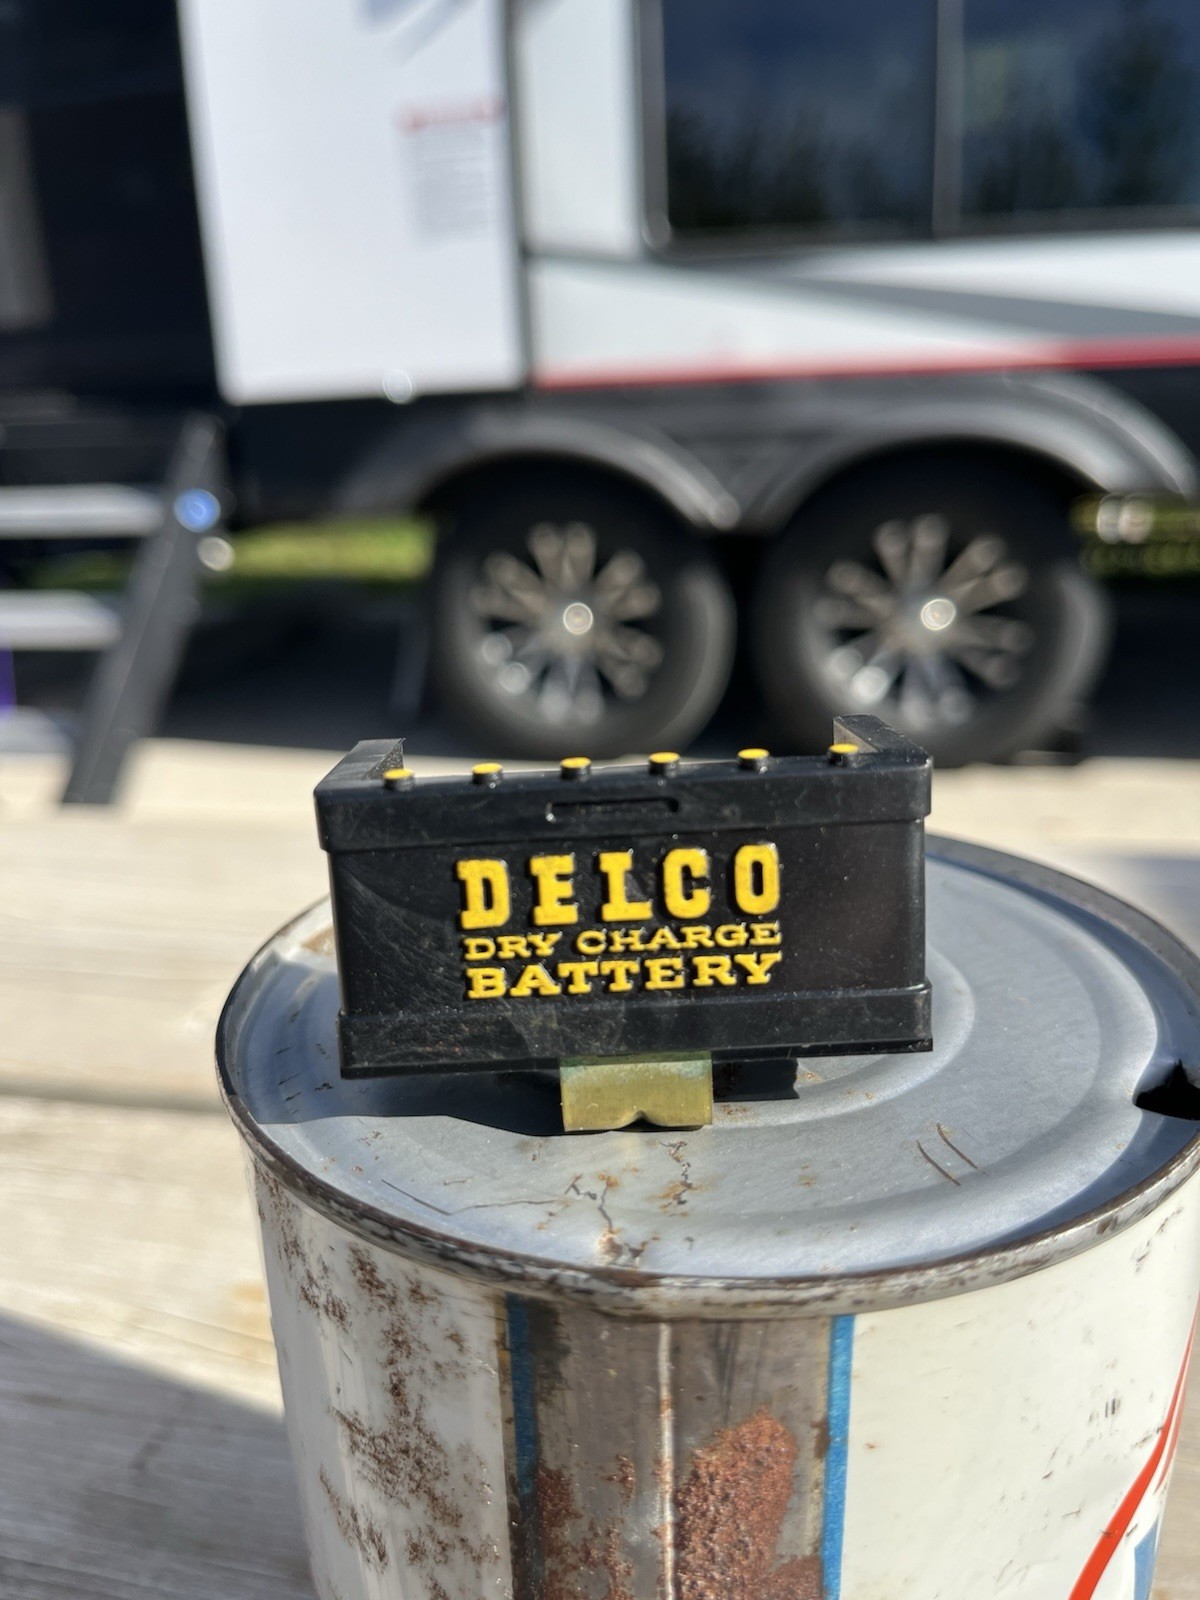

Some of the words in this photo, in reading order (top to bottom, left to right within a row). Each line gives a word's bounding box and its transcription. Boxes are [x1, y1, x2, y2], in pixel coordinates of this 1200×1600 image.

[456, 843, 781, 930] DELCO
[463, 932, 561, 961] DRY
[576, 922, 782, 955] CHARGE
[466, 952, 782, 999] BATTERY
